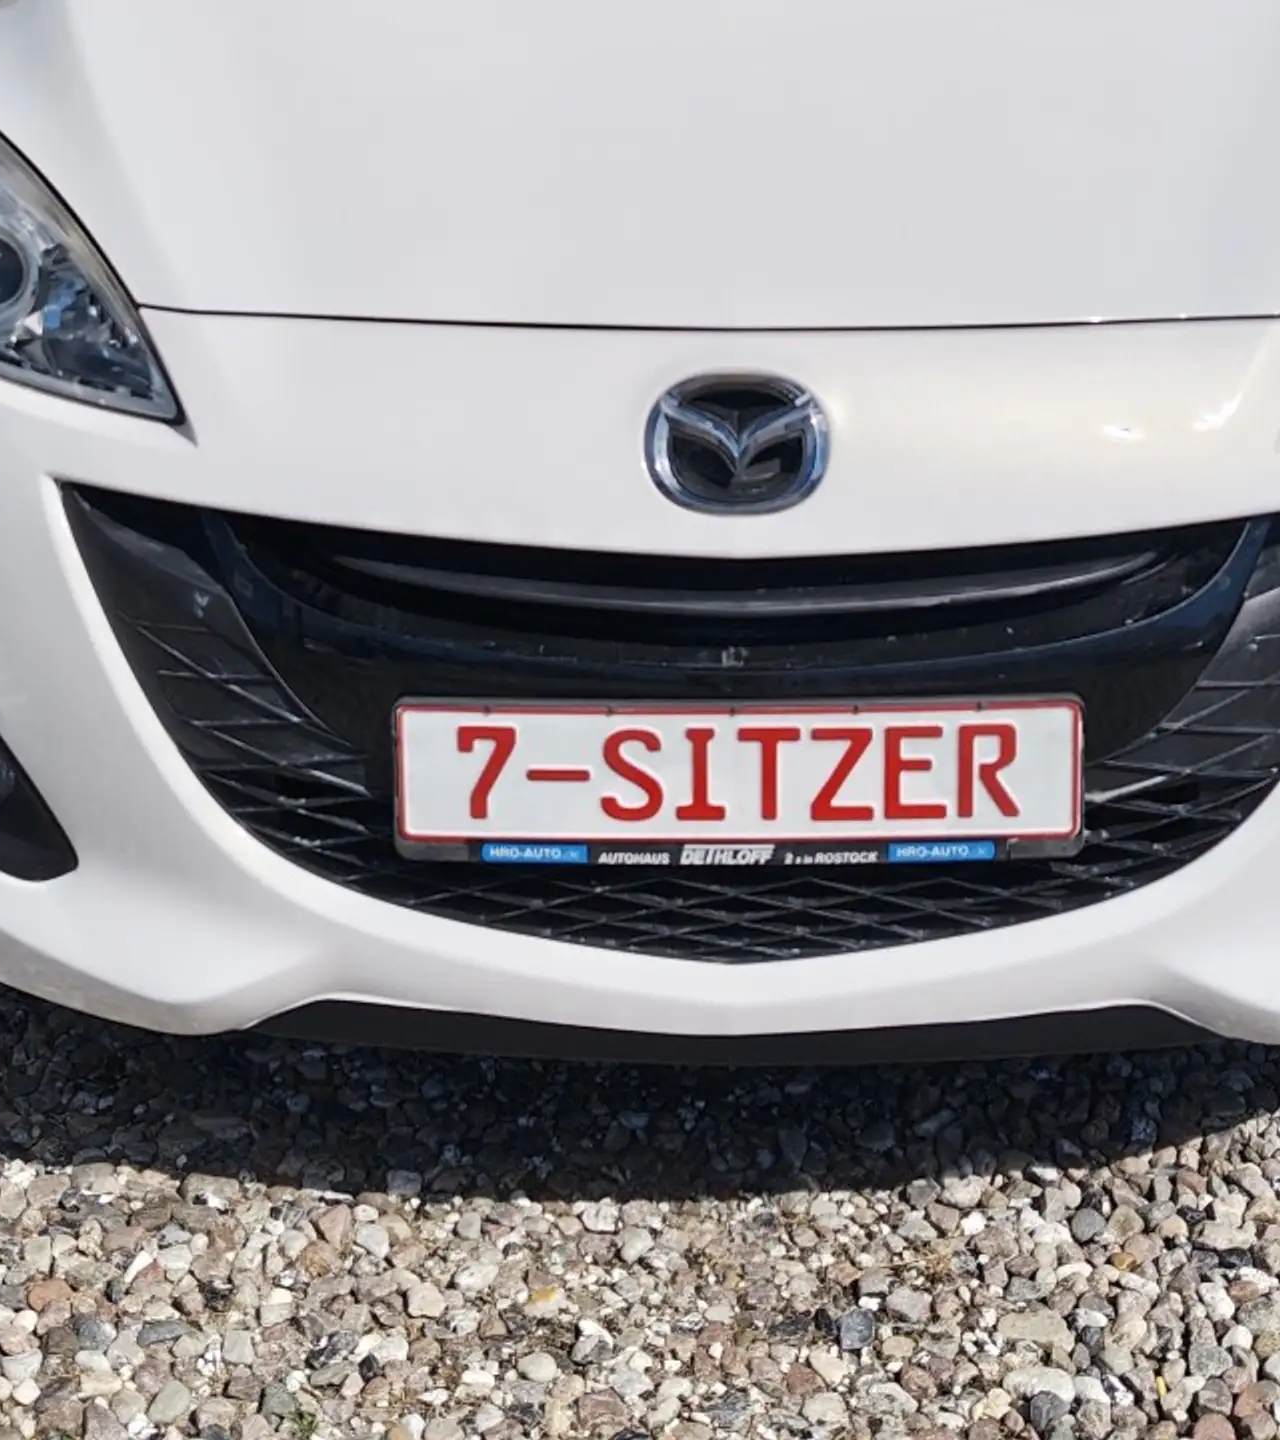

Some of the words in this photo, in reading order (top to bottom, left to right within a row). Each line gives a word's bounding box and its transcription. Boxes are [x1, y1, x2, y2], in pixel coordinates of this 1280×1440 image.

[456, 723, 1020, 822] 7-SITZER
[598, 851, 671, 865] AUTOHAUS
[680, 844, 776, 865] DETHLOFF
[814, 850, 879, 864] ROSTOCK
